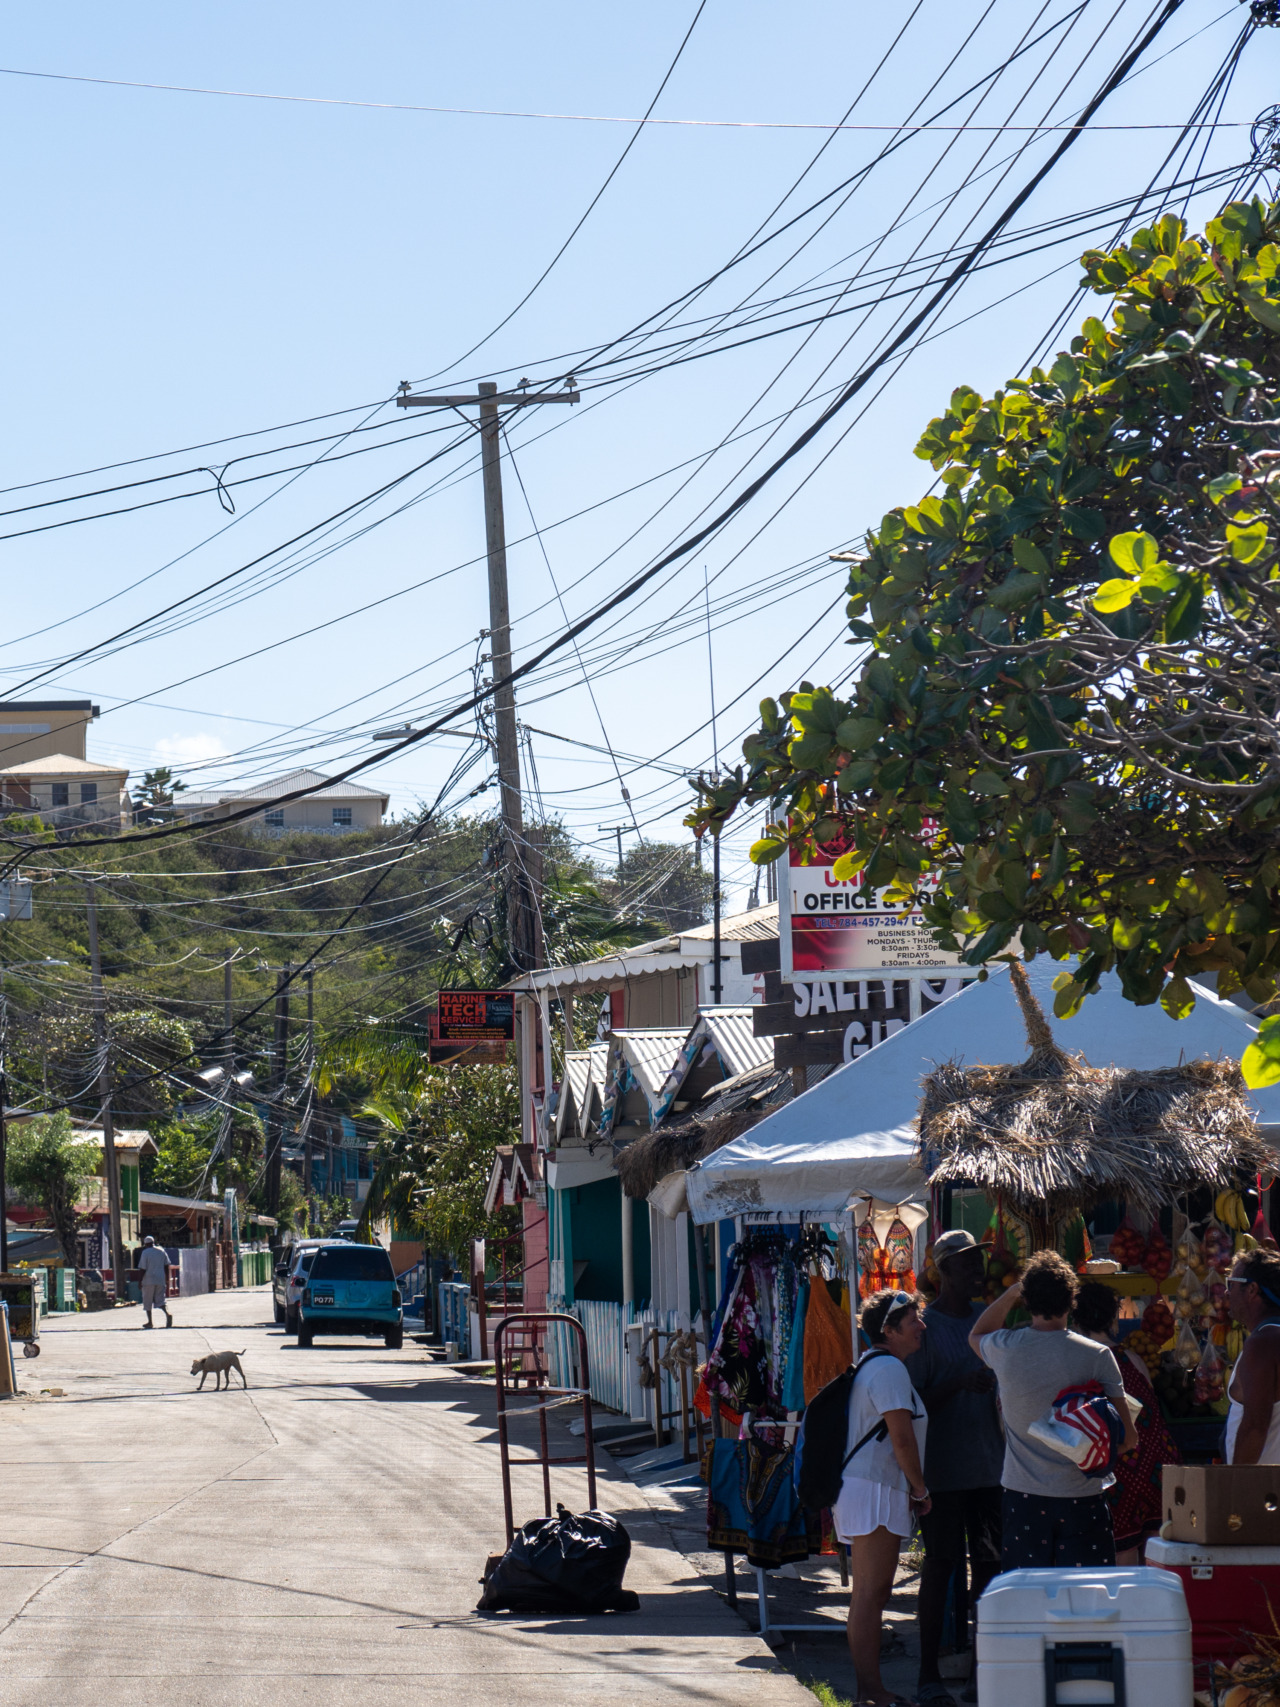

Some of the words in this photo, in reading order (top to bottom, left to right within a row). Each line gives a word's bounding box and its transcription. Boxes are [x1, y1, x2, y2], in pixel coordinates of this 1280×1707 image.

[803, 892, 877, 911] OFFICE
[814, 918, 837, 928] TEL:
[838, 916, 909, 928] 784-457-2947
[916, 959, 947, 967] 4:00pm
[441, 995, 486, 1004] MARINE
[792, 980, 895, 1018] SALTY
[440, 1004, 487, 1016] TECH
[441, 1016, 486, 1024] SERVICES
